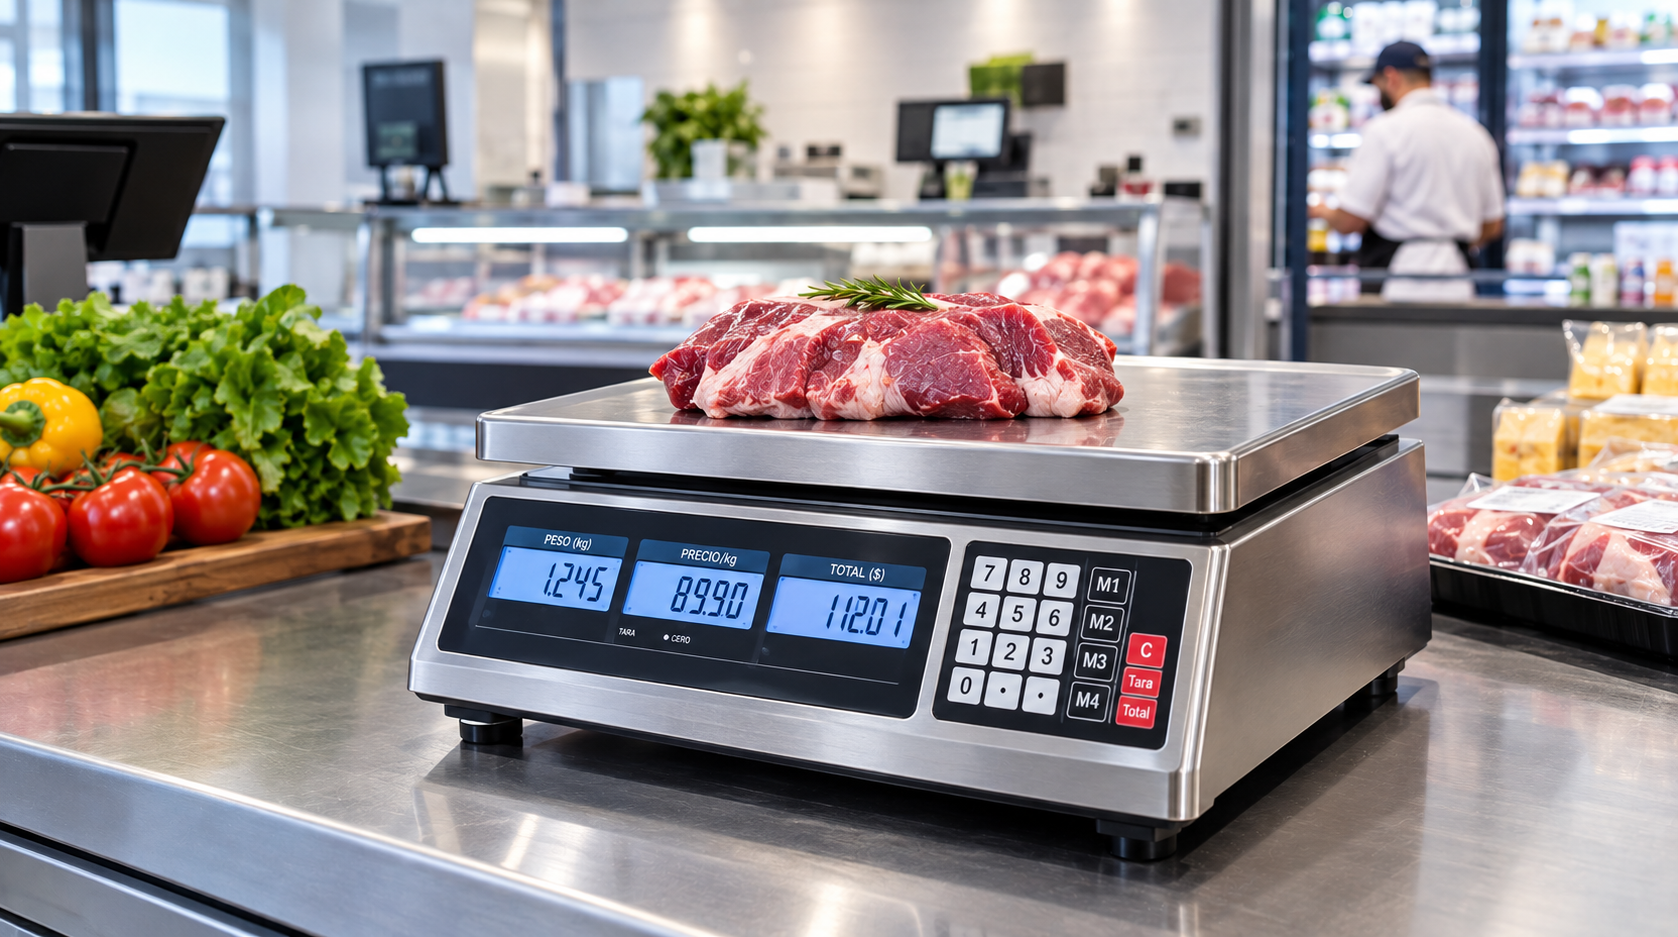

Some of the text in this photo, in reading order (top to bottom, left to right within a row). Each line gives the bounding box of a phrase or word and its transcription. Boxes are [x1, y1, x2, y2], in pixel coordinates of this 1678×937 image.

[543, 534, 592, 551] PESO (kg)
[680, 548, 738, 568] PRECIO/kg
[543, 562, 608, 602] 1.245
[830, 563, 886, 583] TOTAL ($)
[984, 564, 996, 582] 7
[1019, 568, 1031, 585] 8
[1056, 571, 1068, 589] 9
[1096, 576, 1120, 594] M1
[670, 575, 749, 620] 89.90
[826, 594, 908, 638] 112.01
[975, 601, 987, 618] 4
[1011, 605, 1024, 622] 5
[1048, 608, 1061, 627] 6
[1089, 613, 1114, 631] M2
[618, 628, 636, 637] TARA
[671, 634, 691, 644] CERO
[970, 638, 979, 656] 1
[1003, 642, 1017, 660] 2
[1041, 646, 1054, 665] 3
[1140, 642, 1153, 658] C
[1082, 652, 1107, 670] M3
[960, 676, 972, 695] 0
[1128, 674, 1154, 690] Tara
[1075, 691, 1100, 709] M4
[1123, 703, 1150, 720] Total
